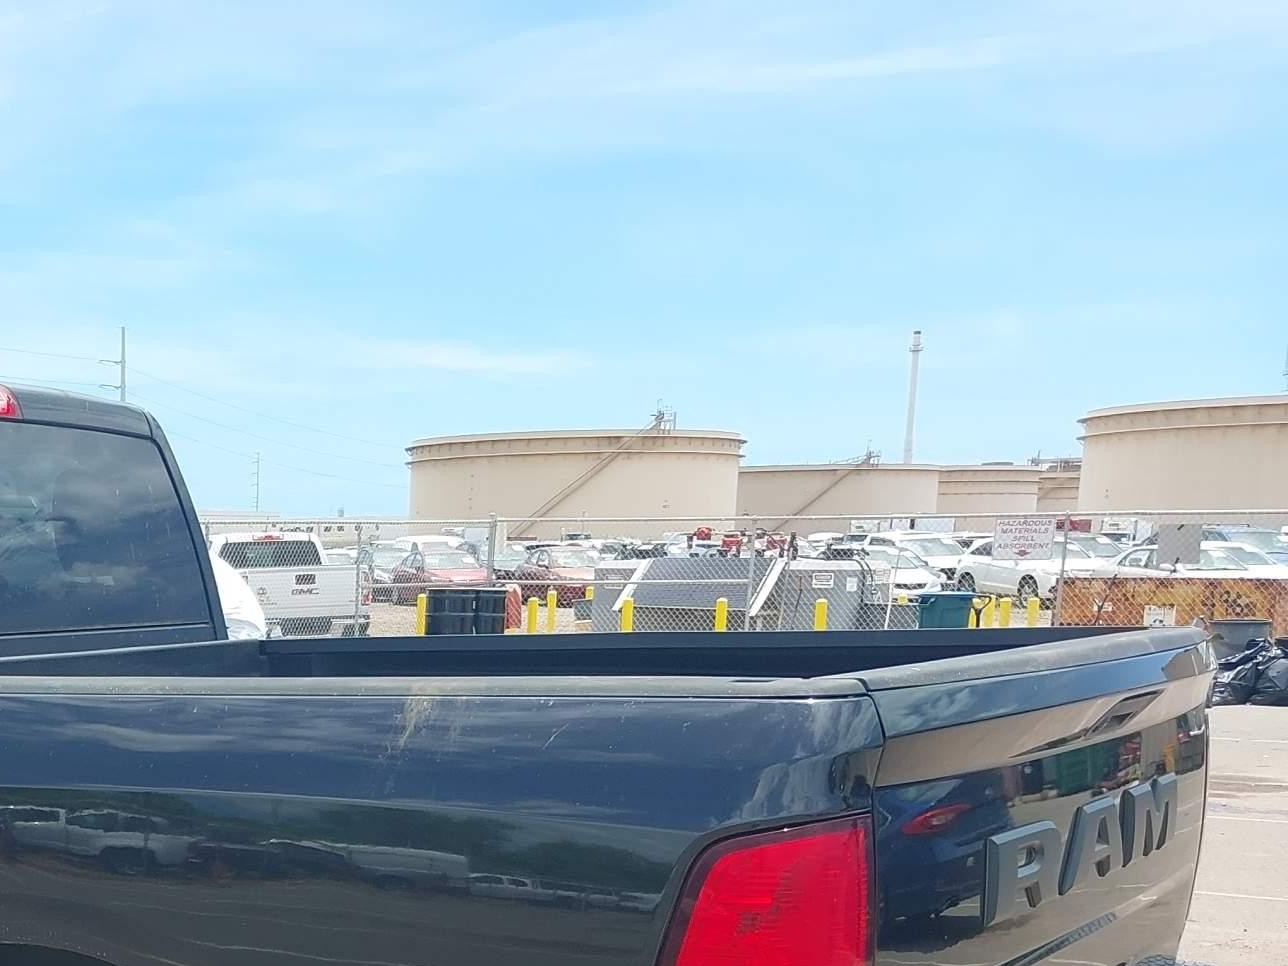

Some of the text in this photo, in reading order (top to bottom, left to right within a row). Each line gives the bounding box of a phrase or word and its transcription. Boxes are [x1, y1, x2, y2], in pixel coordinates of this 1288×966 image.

[998, 519, 1053, 527] HAZARDOUS
[996, 542, 1050, 550] ABSORBENT
[291, 587, 320, 596] GMC
[983, 772, 1178, 928] RAM
